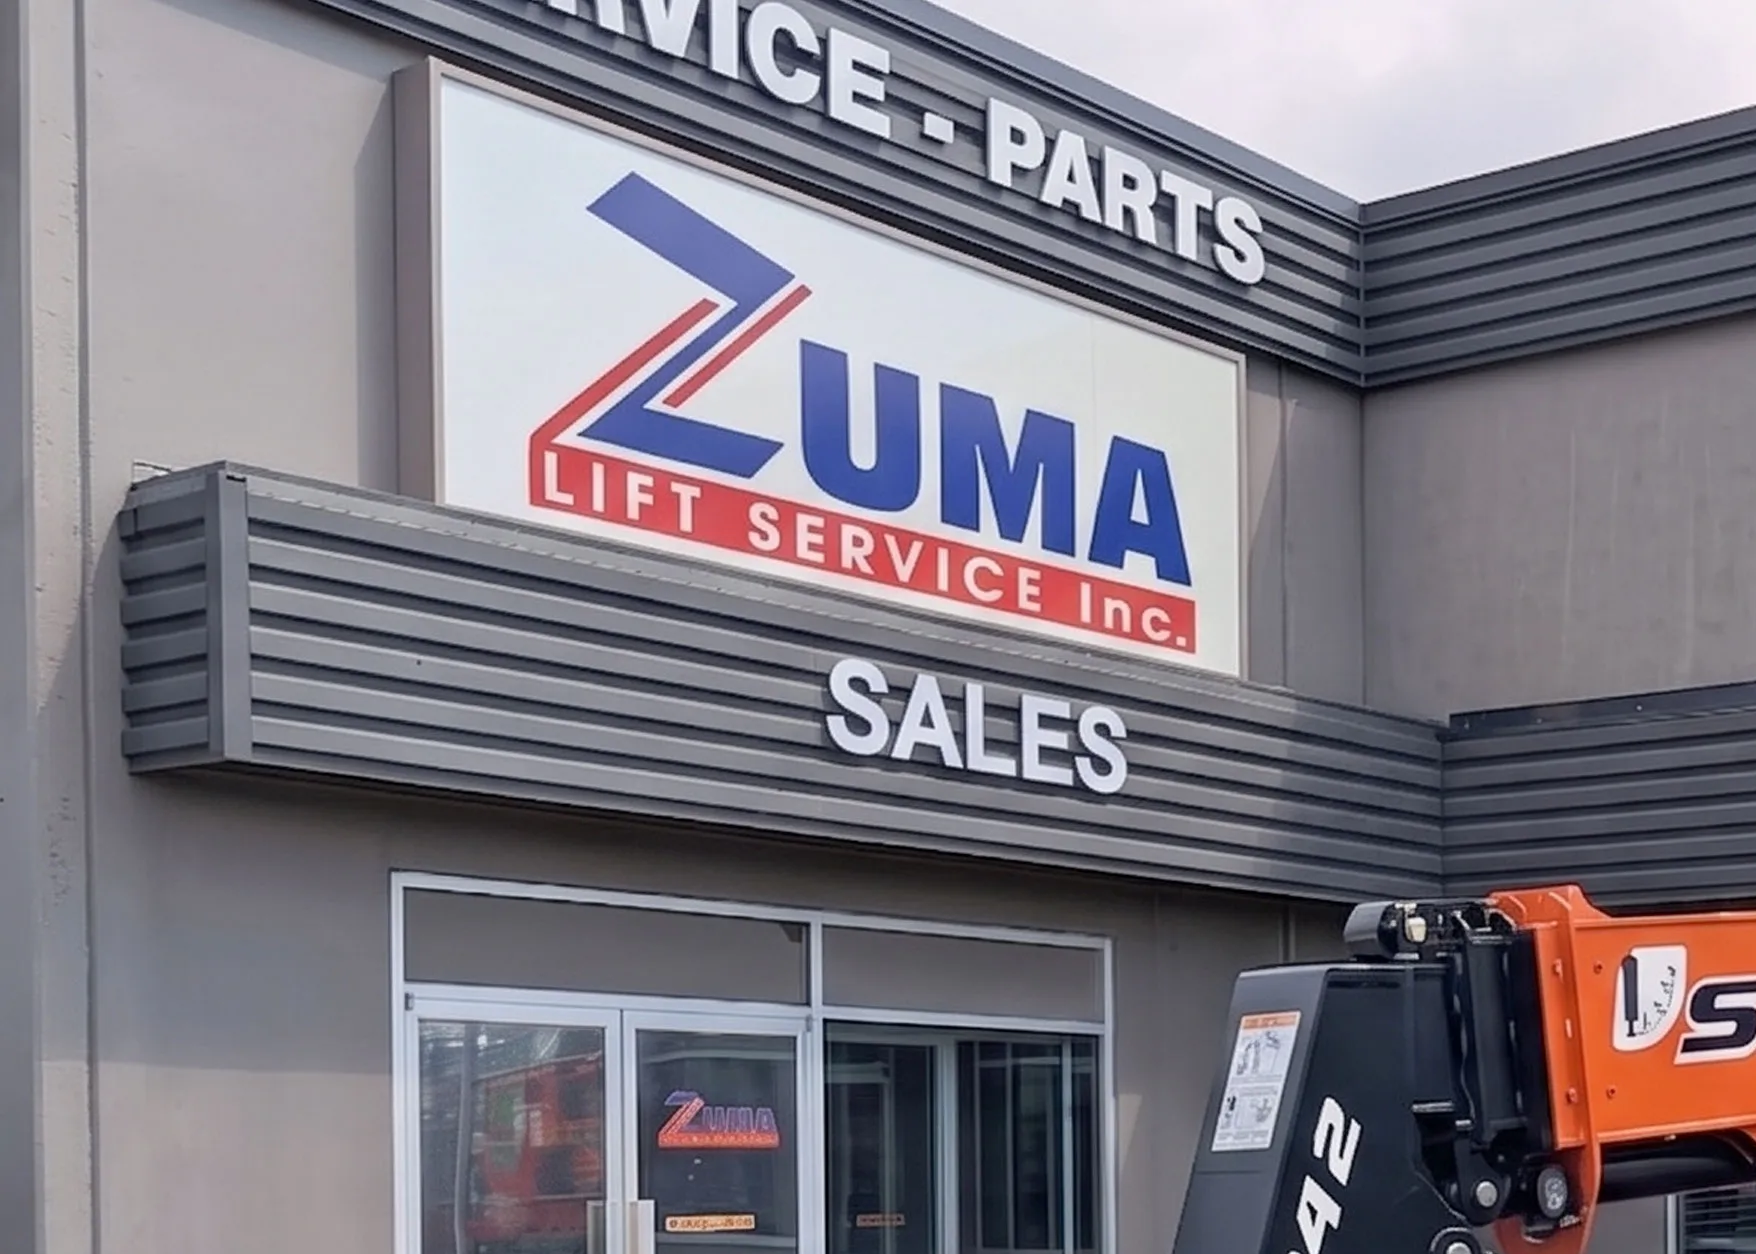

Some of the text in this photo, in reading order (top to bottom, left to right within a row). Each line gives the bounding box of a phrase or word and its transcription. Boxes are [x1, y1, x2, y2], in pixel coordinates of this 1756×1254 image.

[986, 97, 1266, 284] PARTS
[576, 171, 1193, 588] ZUMA
[544, 450, 1187, 648] LIFT SERVICE Inc.
[825, 657, 1129, 794] SALES
